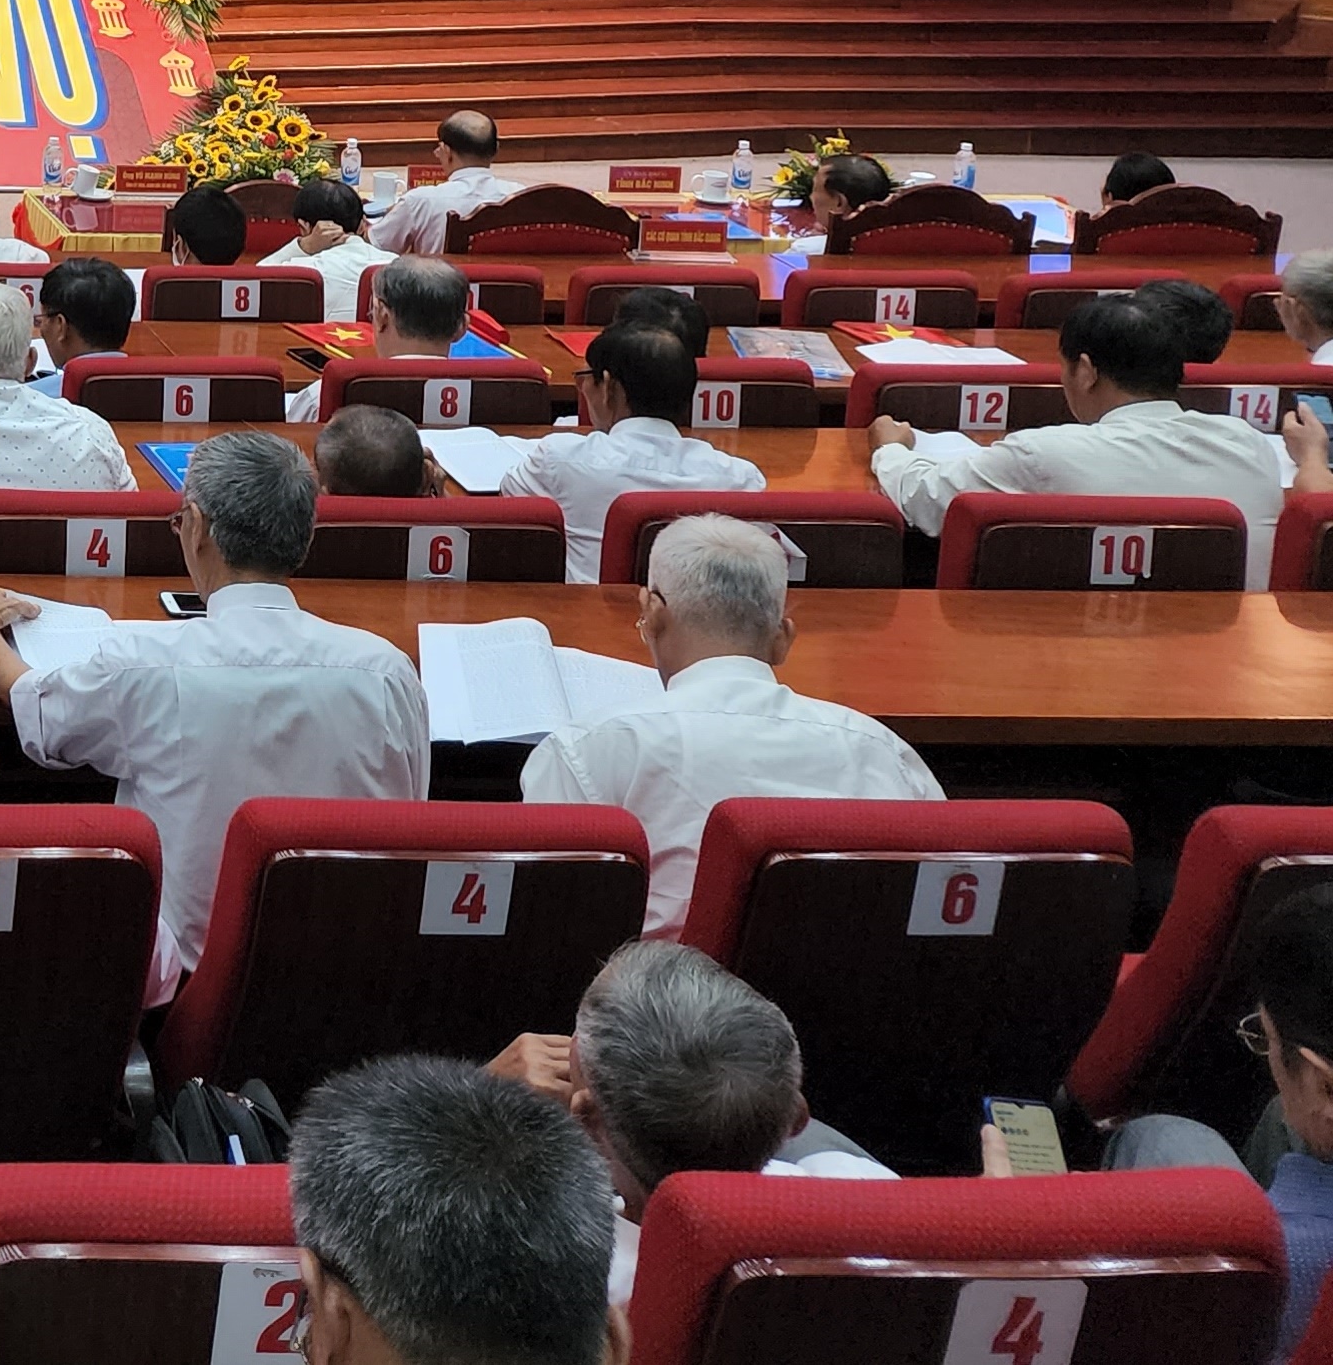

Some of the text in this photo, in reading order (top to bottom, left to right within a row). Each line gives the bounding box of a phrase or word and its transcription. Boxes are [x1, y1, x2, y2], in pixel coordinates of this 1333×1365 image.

[235, 286, 250, 311] 8
[881, 295, 910, 320] 14
[174, 384, 193, 416] 6
[440, 387, 458, 417] 8
[698, 389, 735, 421] 10
[965, 391, 1004, 423] 12
[1236, 394, 1271, 424] 14
[86, 528, 110, 567] 4
[429, 534, 453, 575] 6
[1098, 535, 1145, 576] 10
[451, 873, 487, 924] 4
[941, 872, 979, 924] 6
[255, 1282, 303, 1353] 2
[991, 1296, 1045, 1365] 4
